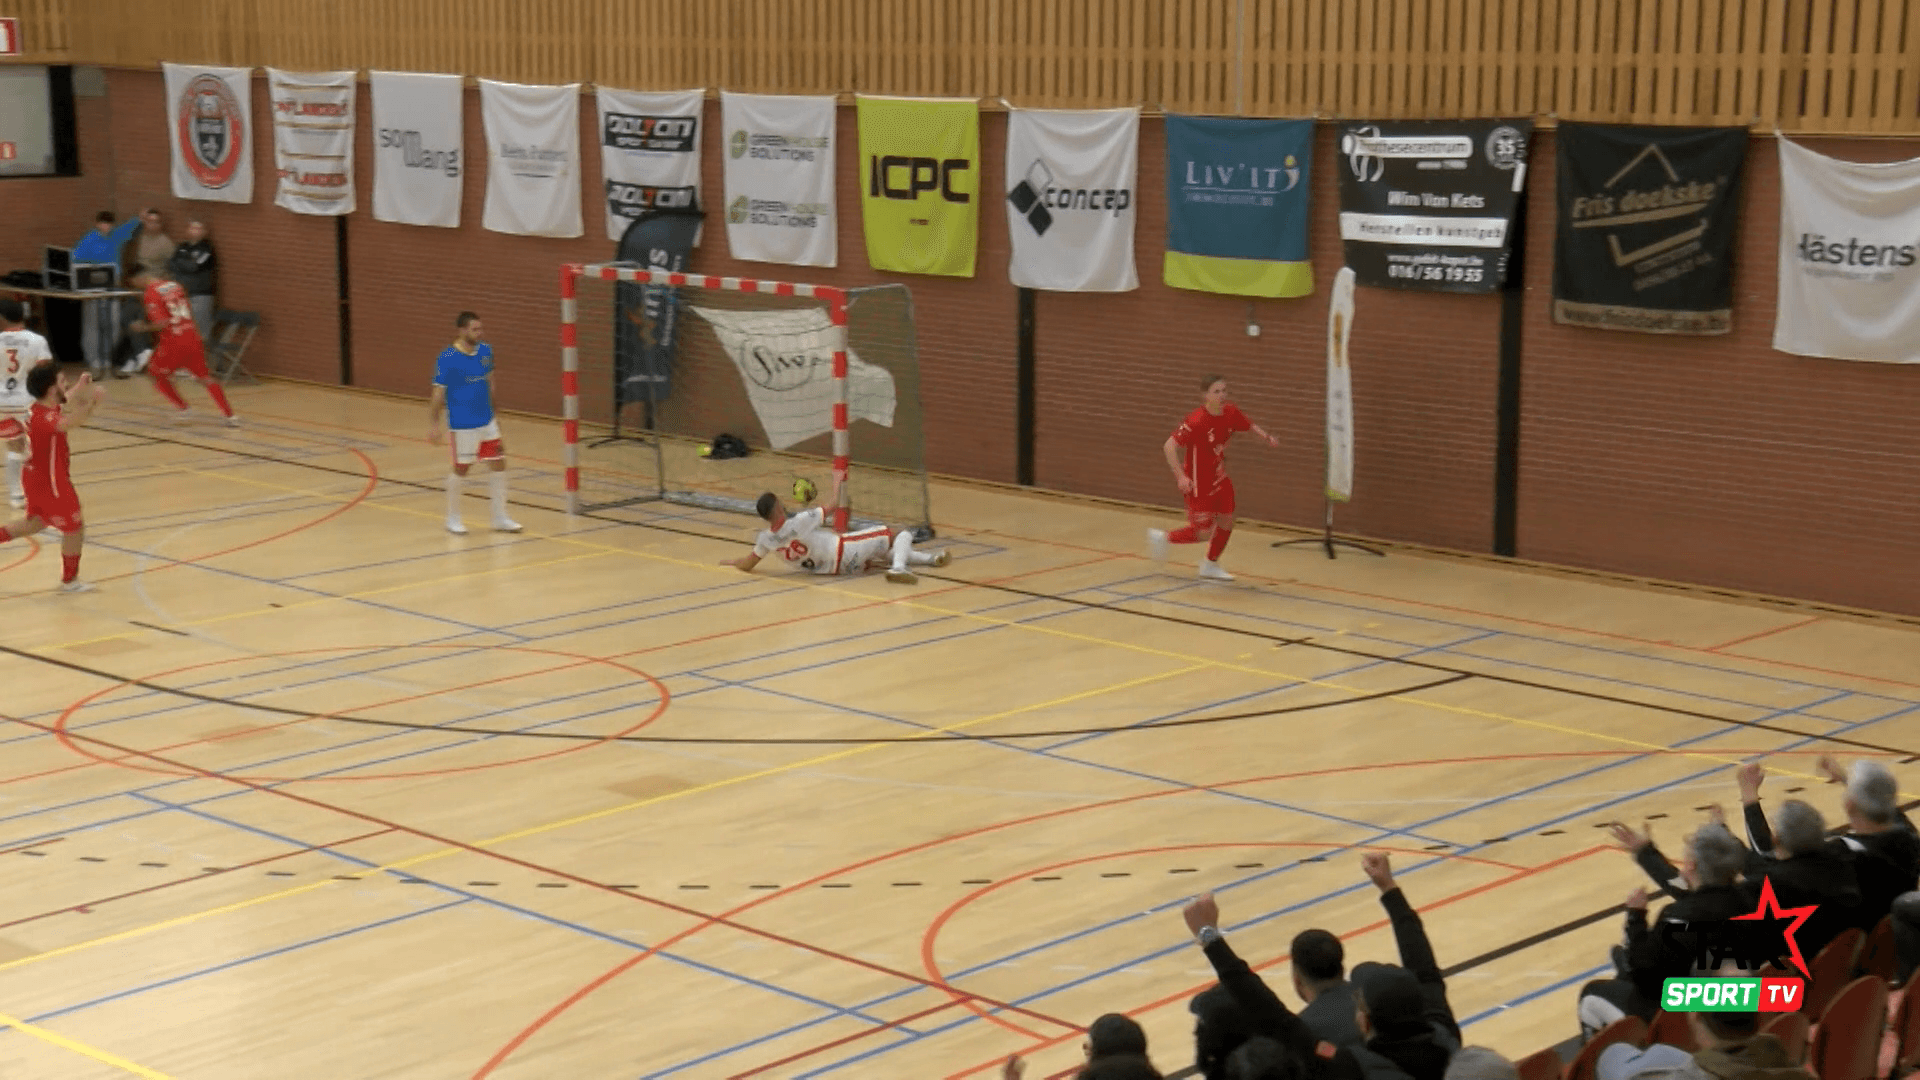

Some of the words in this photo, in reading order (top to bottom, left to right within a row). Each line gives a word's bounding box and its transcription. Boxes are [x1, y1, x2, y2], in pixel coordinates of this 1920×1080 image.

[750, 147, 815, 161] SOLUTIONS
[869, 154, 971, 204] ICPC
[1045, 187, 1130, 218] concap
[1387, 190, 1421, 206] Wim
[1571, 193, 1616, 219] Fris
[750, 213, 818, 228] SOLUTIONS
[6, 348, 20, 374] 3
